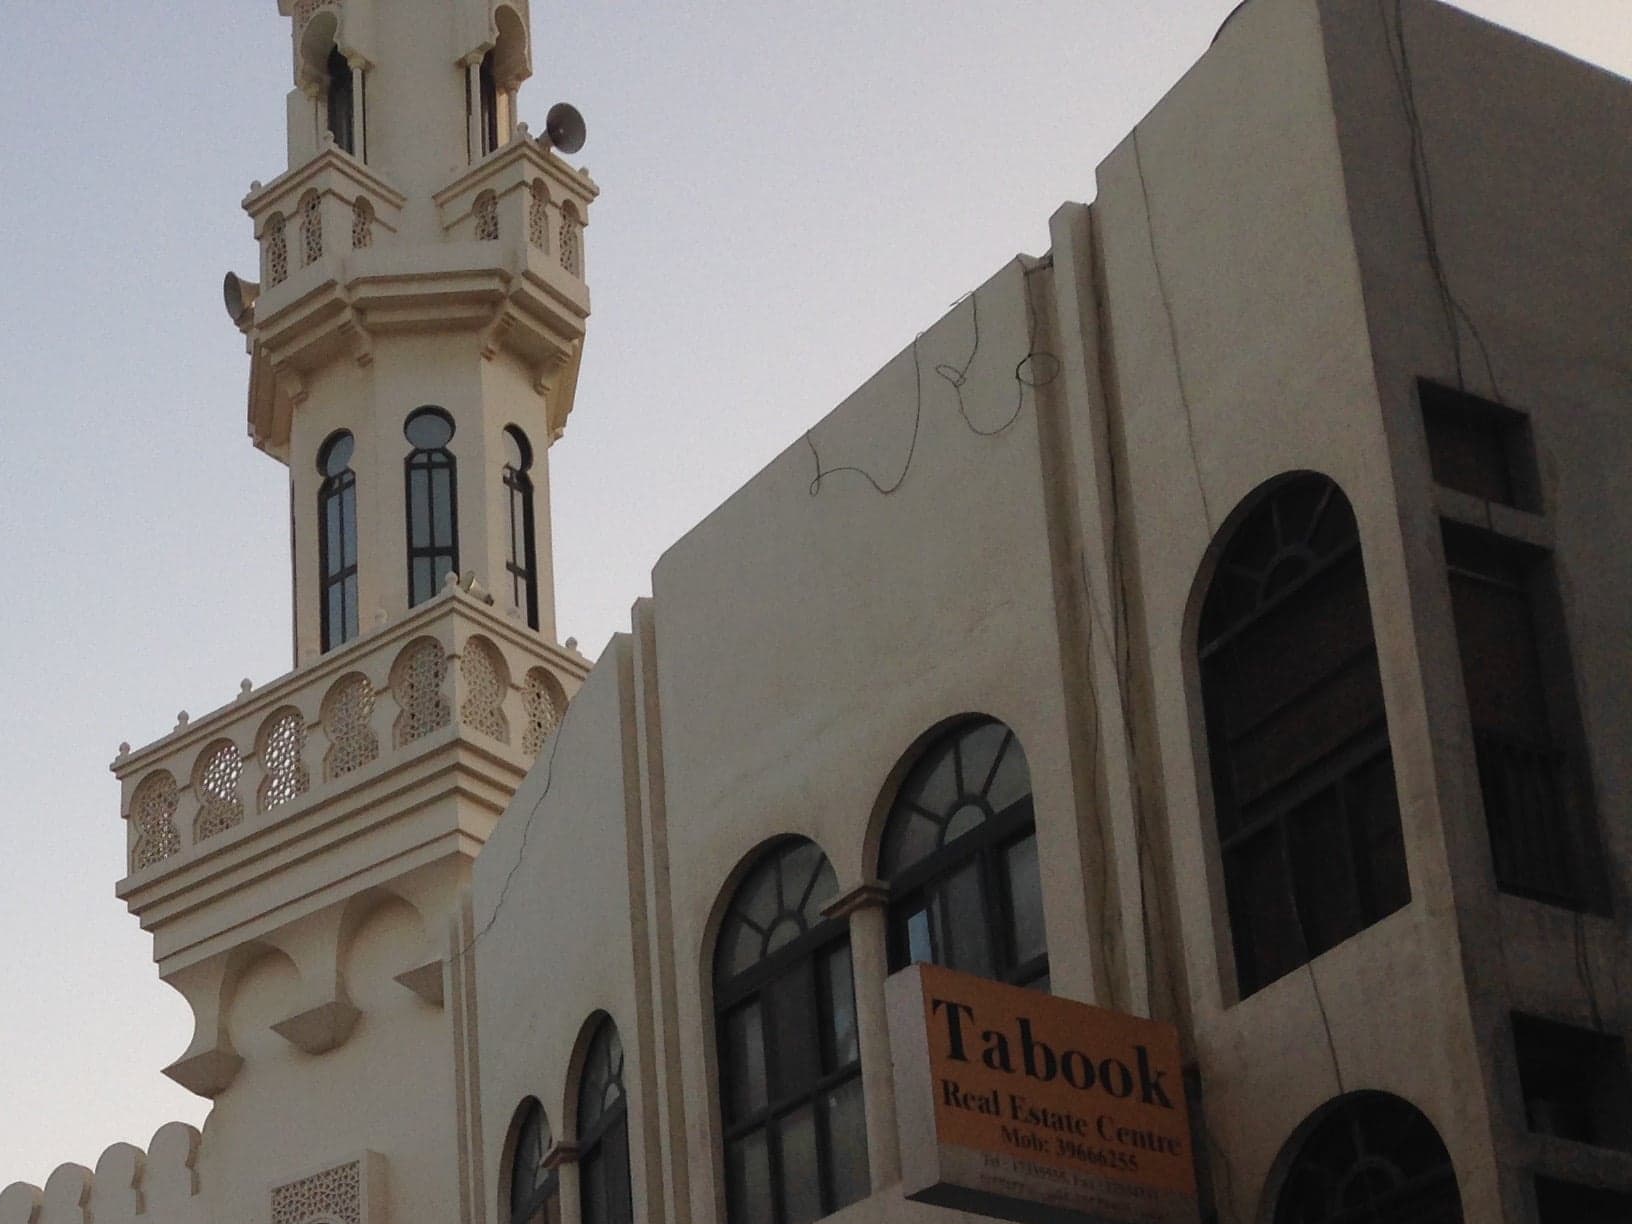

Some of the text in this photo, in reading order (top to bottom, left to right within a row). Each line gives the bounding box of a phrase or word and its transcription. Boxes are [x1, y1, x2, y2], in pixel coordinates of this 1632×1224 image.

[932, 998, 1175, 1109] Tabook
[940, 1079, 1183, 1156] Real Estate Centre
